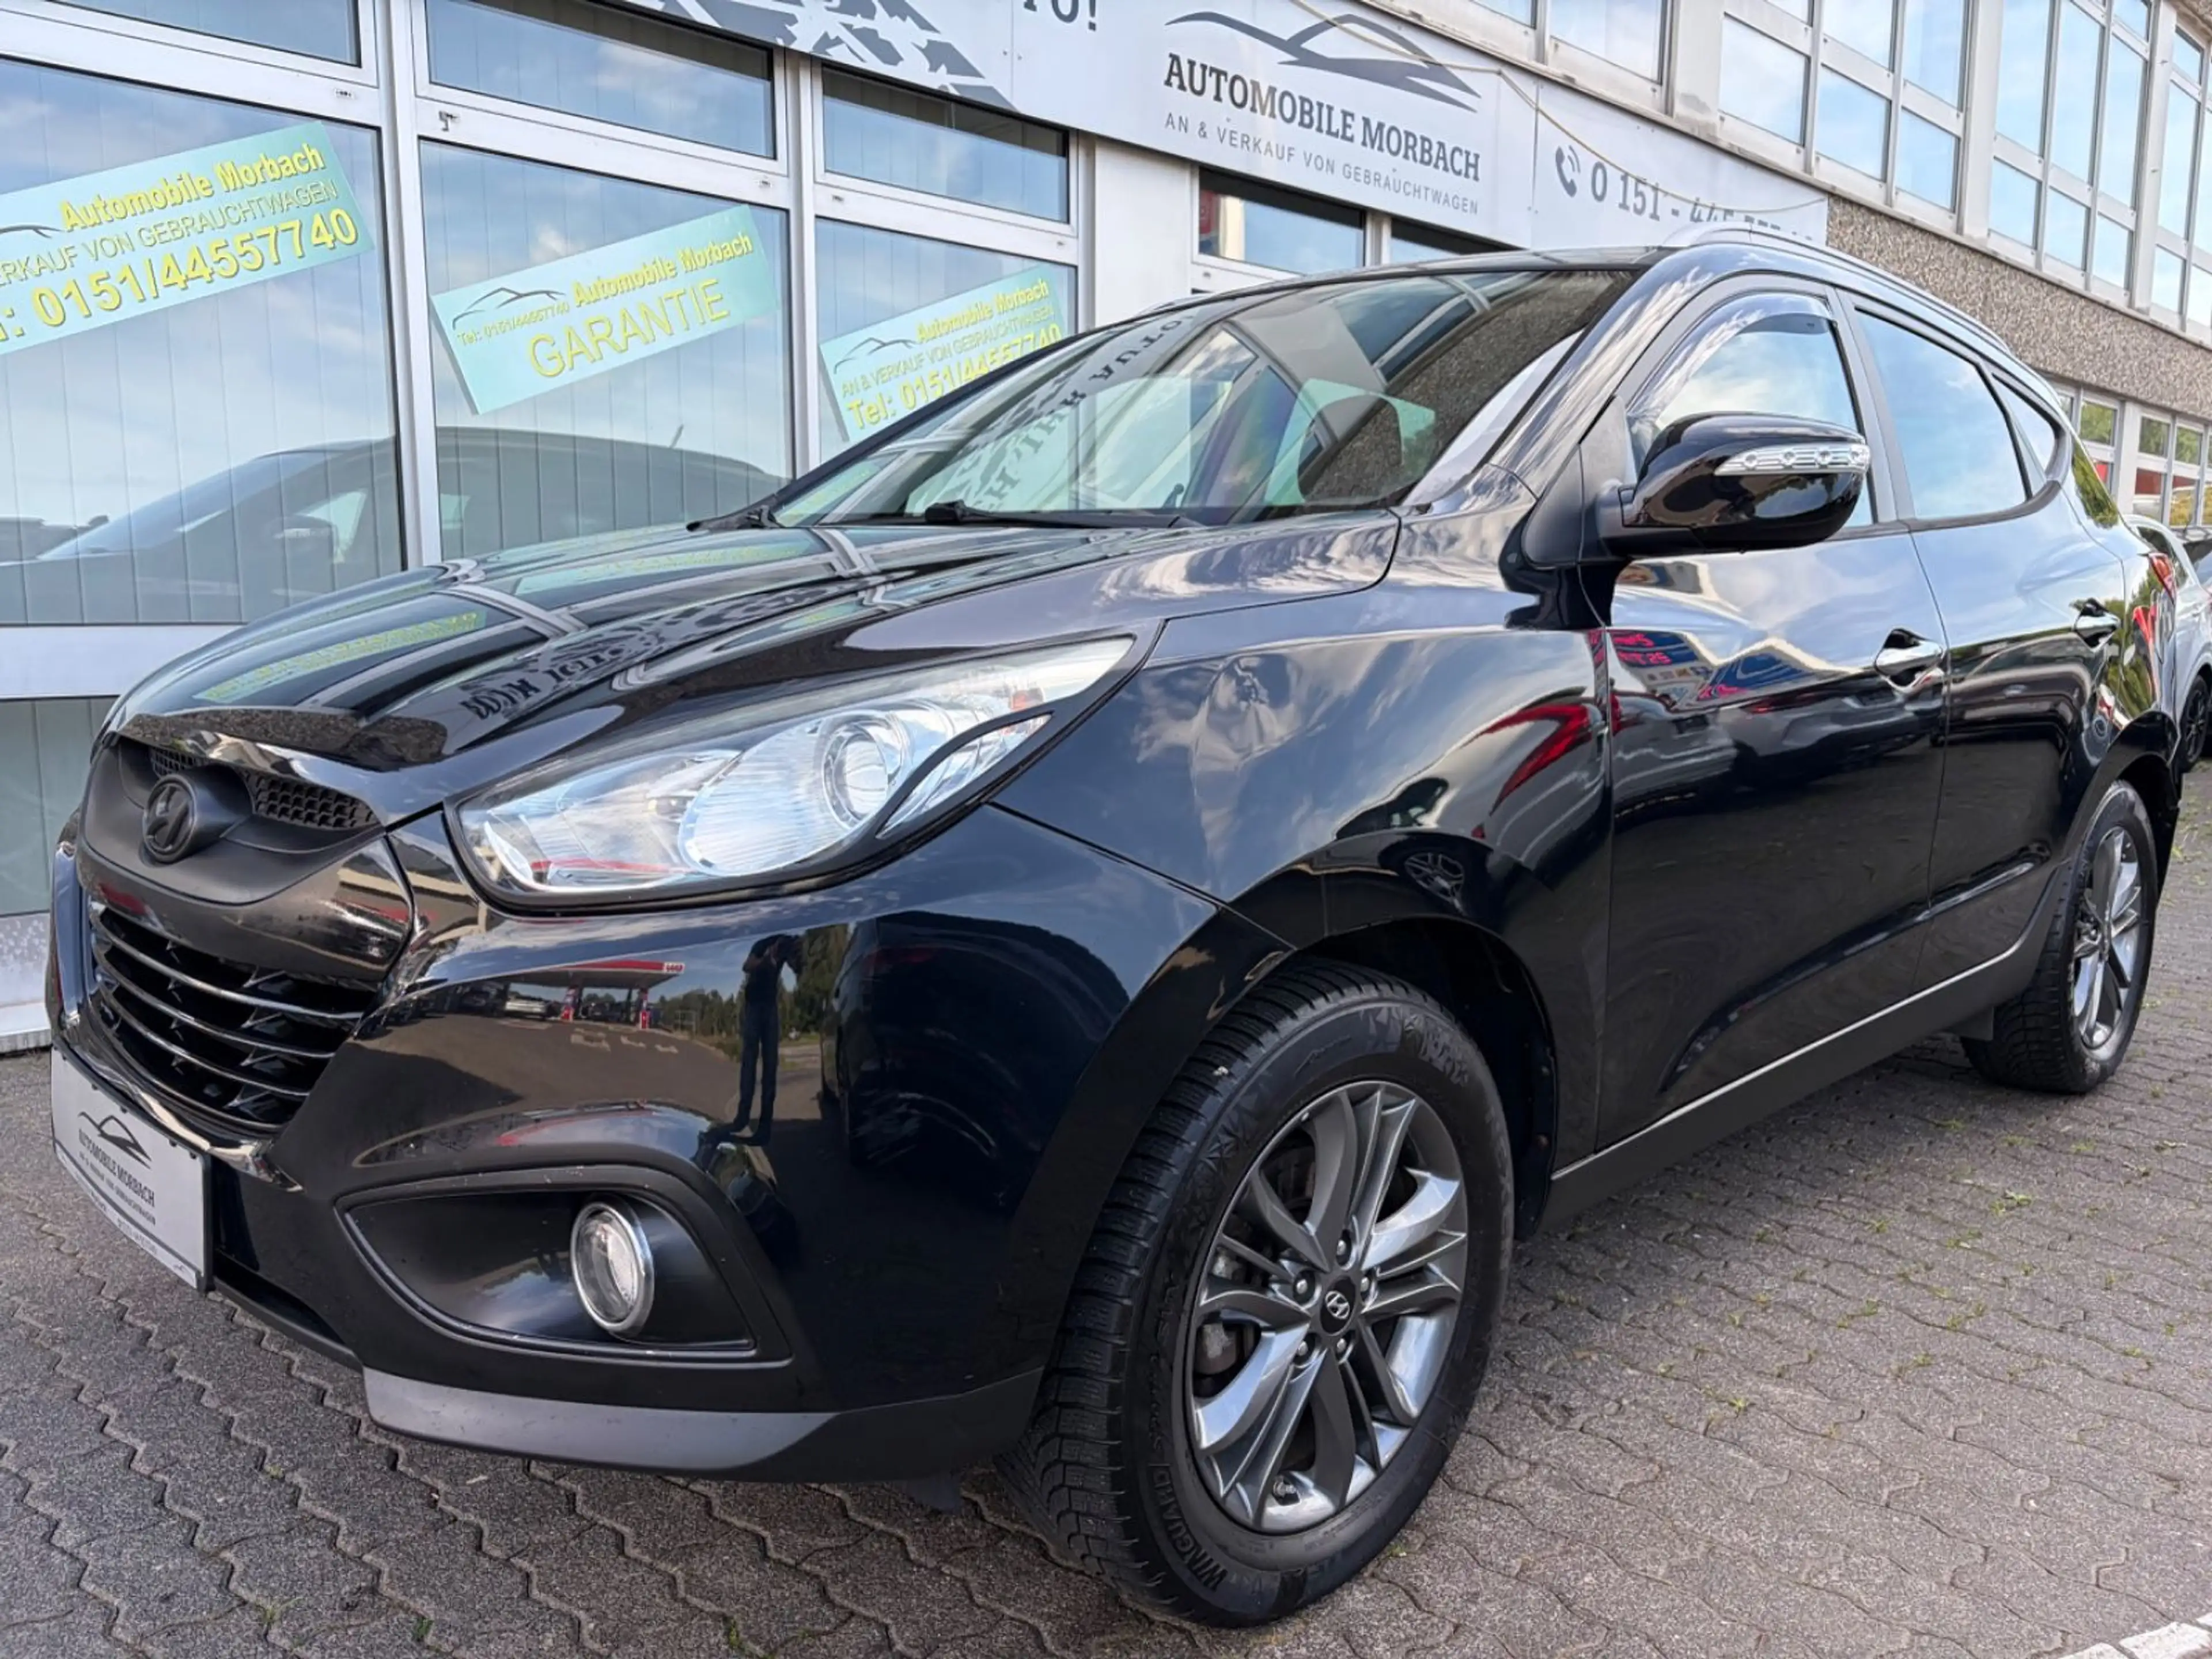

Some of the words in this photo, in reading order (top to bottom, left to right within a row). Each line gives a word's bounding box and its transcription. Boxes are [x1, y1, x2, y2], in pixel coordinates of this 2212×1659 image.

[1164, 54, 1355, 142] AUTOMOBILE
[1361, 116, 1480, 182] MORBACH
[62, 177, 213, 232] Automobile
[215, 143, 325, 193] Morbach
[1165, 113, 1188, 134] AN
[1199, 122, 1208, 138] &
[1218, 127, 1296, 162] VERKAUF
[1303, 151, 1335, 175] VON
[1342, 165, 1478, 215] GEBRAUCHTWAGEN
[1592, 161, 1608, 202] 0
[1618, 173, 1660, 222] 151
[81, 232, 135, 261] VON
[140, 180, 338, 248] GEBRAUCHTWAGEN
[32, 207, 358, 327] 0151/44557740
[571, 259, 677, 307] Automobile
[679, 231, 753, 272] Morbach
[528, 278, 729, 378] GARANTIE
[916, 301, 993, 344] Automobile
[995, 277, 1049, 314] Morbach
[842, 377, 859, 398] AN
[871, 350, 925, 386] VERKAUF
[926, 341, 952, 364] VON
[849, 393, 896, 430] Tel:
